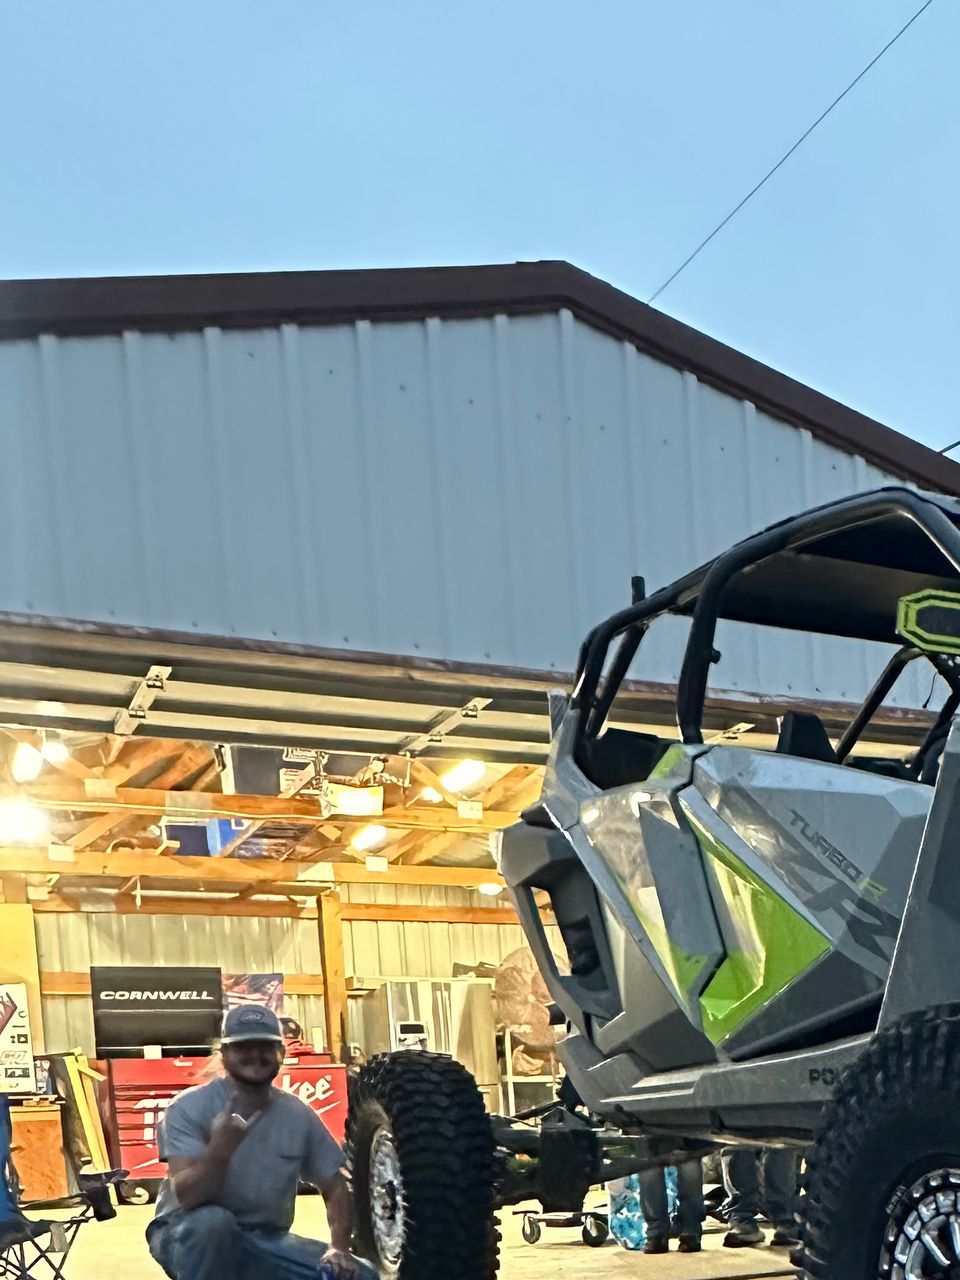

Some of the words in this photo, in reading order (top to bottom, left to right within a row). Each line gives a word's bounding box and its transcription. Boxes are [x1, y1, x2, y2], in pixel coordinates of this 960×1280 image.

[789, 808, 864, 883] TURBO
[858, 876, 889, 902] R
[99, 990, 215, 1000] CORNWELL
